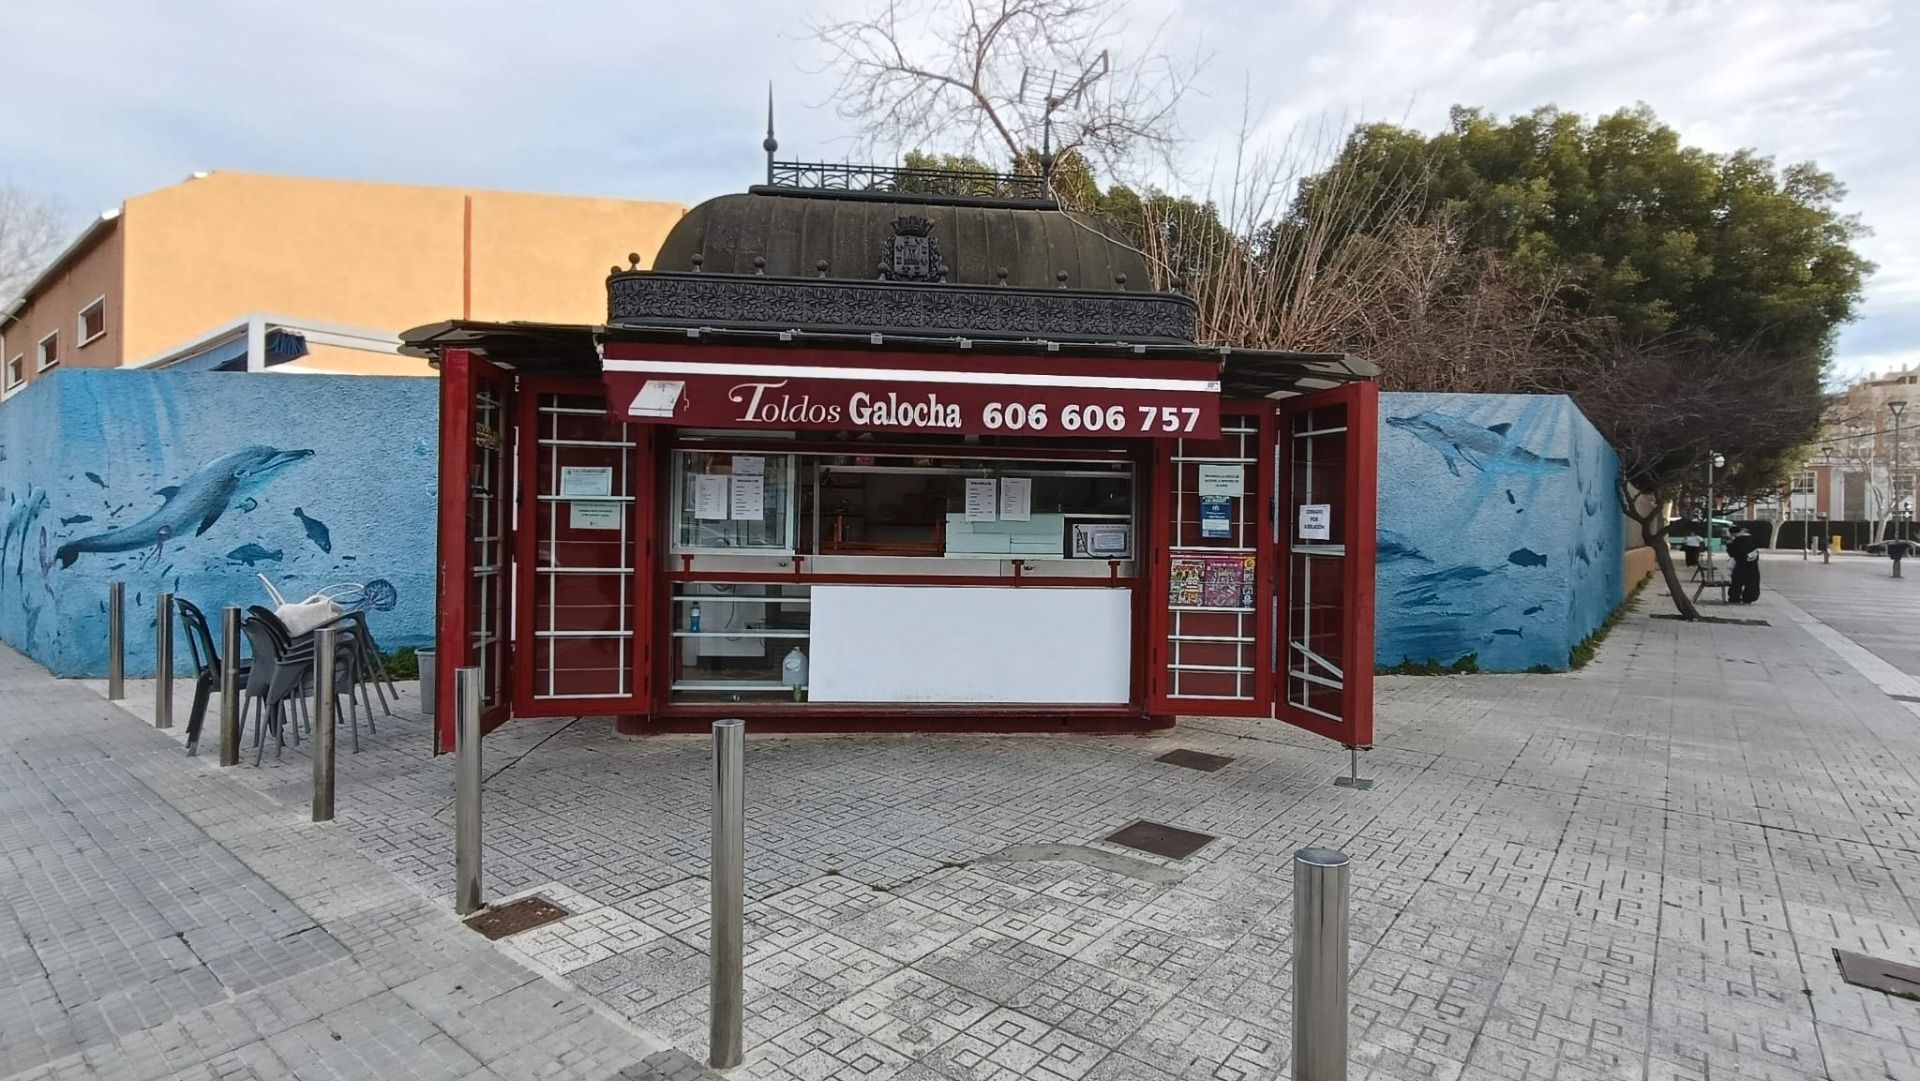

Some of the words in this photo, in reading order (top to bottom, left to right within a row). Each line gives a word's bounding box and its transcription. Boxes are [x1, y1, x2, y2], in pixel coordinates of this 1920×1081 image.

[728, 379, 841, 424] Toldos
[848, 391, 963, 429] Galocha
[982, 402, 1048, 430] 606
[1060, 404, 1126, 431] 606
[1138, 406, 1201, 433] 757
